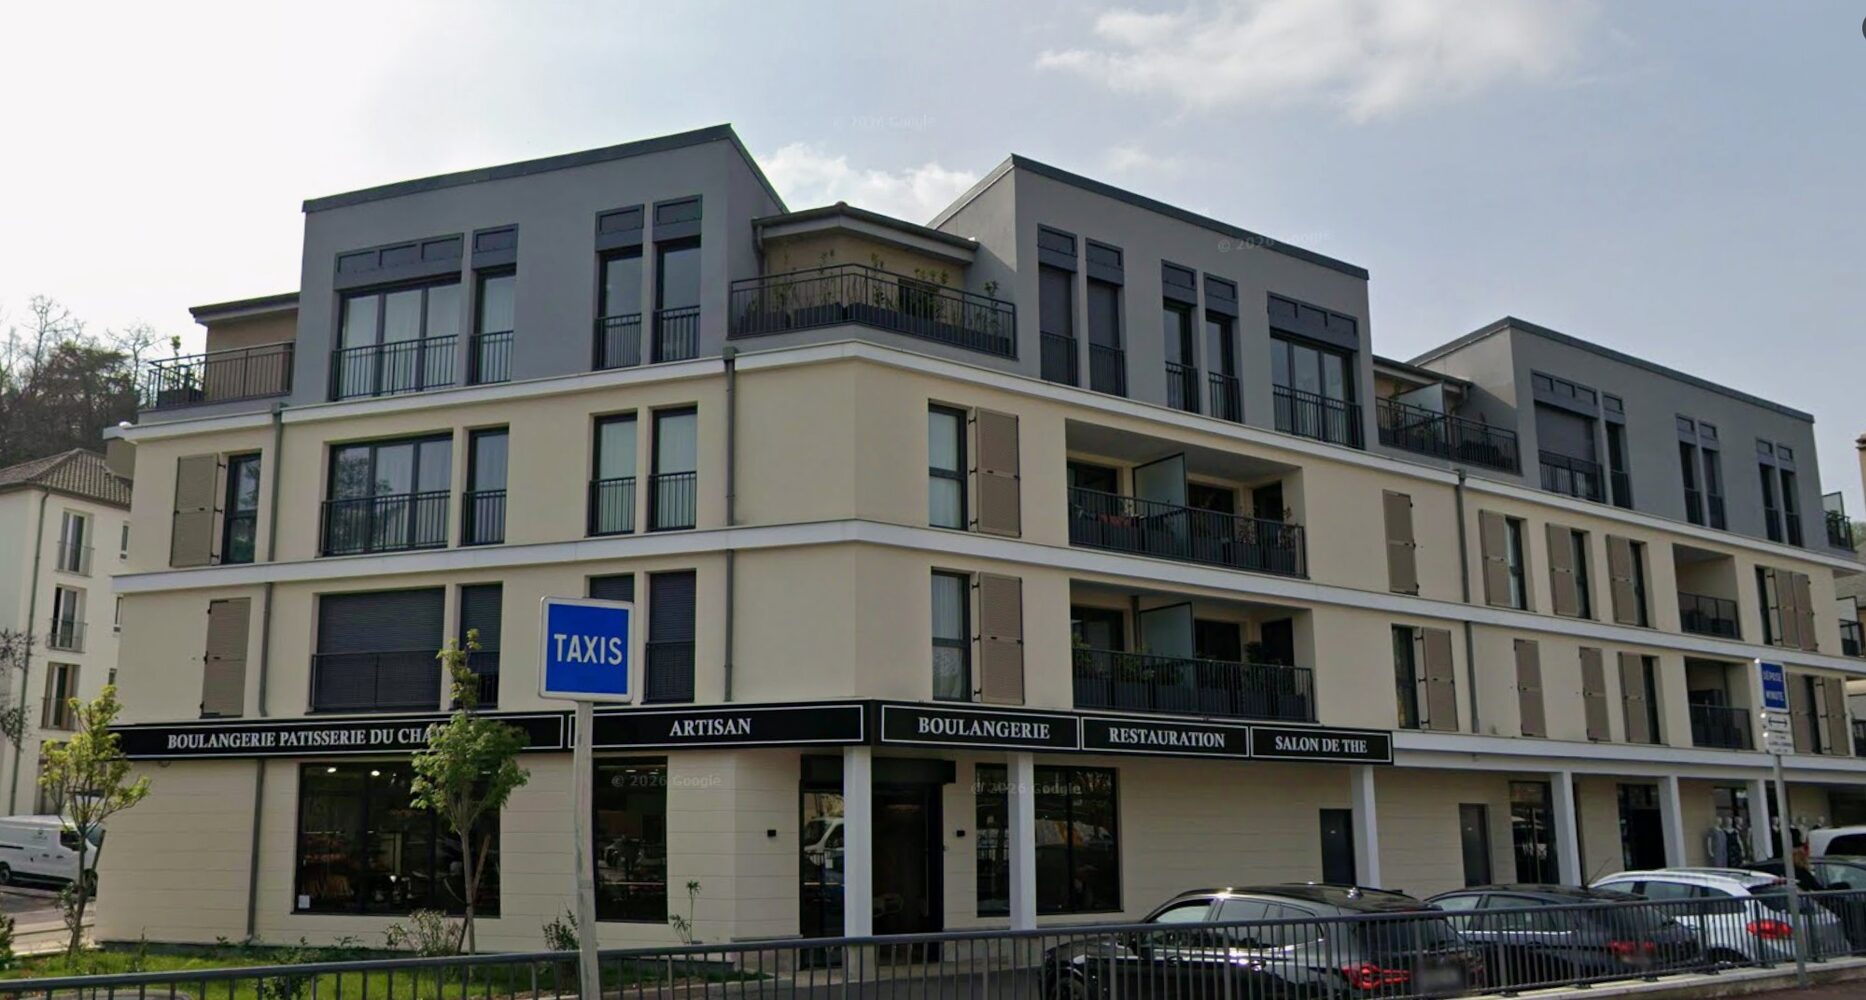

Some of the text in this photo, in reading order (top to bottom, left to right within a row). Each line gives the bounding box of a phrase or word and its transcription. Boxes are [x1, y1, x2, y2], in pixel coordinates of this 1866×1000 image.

[554, 633, 623, 666] TAXIS
[669, 717, 752, 737] ARTISAN
[918, 716, 1051, 740] BOULANGERIE
[1108, 727, 1226, 748] RESTAURATION
[167, 731, 277, 749] BOULANGERIE
[279, 729, 367, 747] PATISSERIE
[369, 728, 395, 745] DU
[1275, 735, 1369, 754] SALON DE THE
